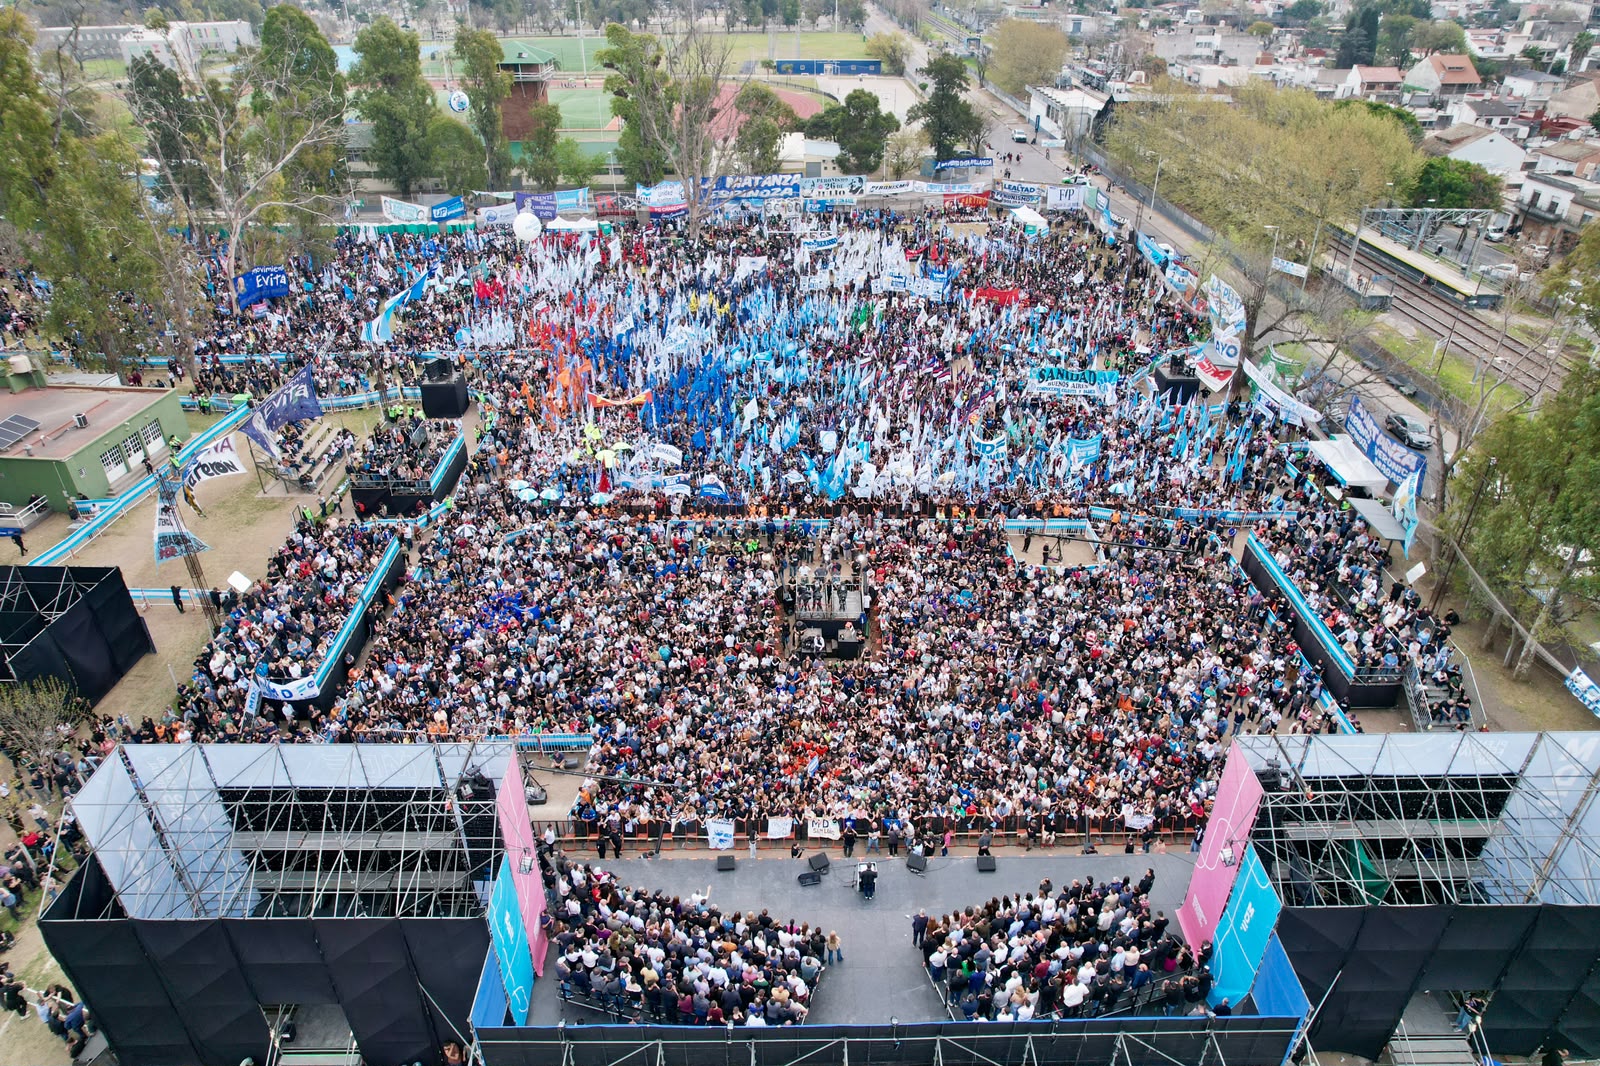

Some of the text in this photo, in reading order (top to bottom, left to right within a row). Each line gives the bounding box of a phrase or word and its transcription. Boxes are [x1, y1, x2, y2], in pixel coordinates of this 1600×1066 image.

[725, 174, 801, 188] MATANZA
[1003, 183, 1036, 193] LEALTAD
[1038, 367, 1097, 386] SANIDAD
[1375, 444, 1409, 477] VERONIC
